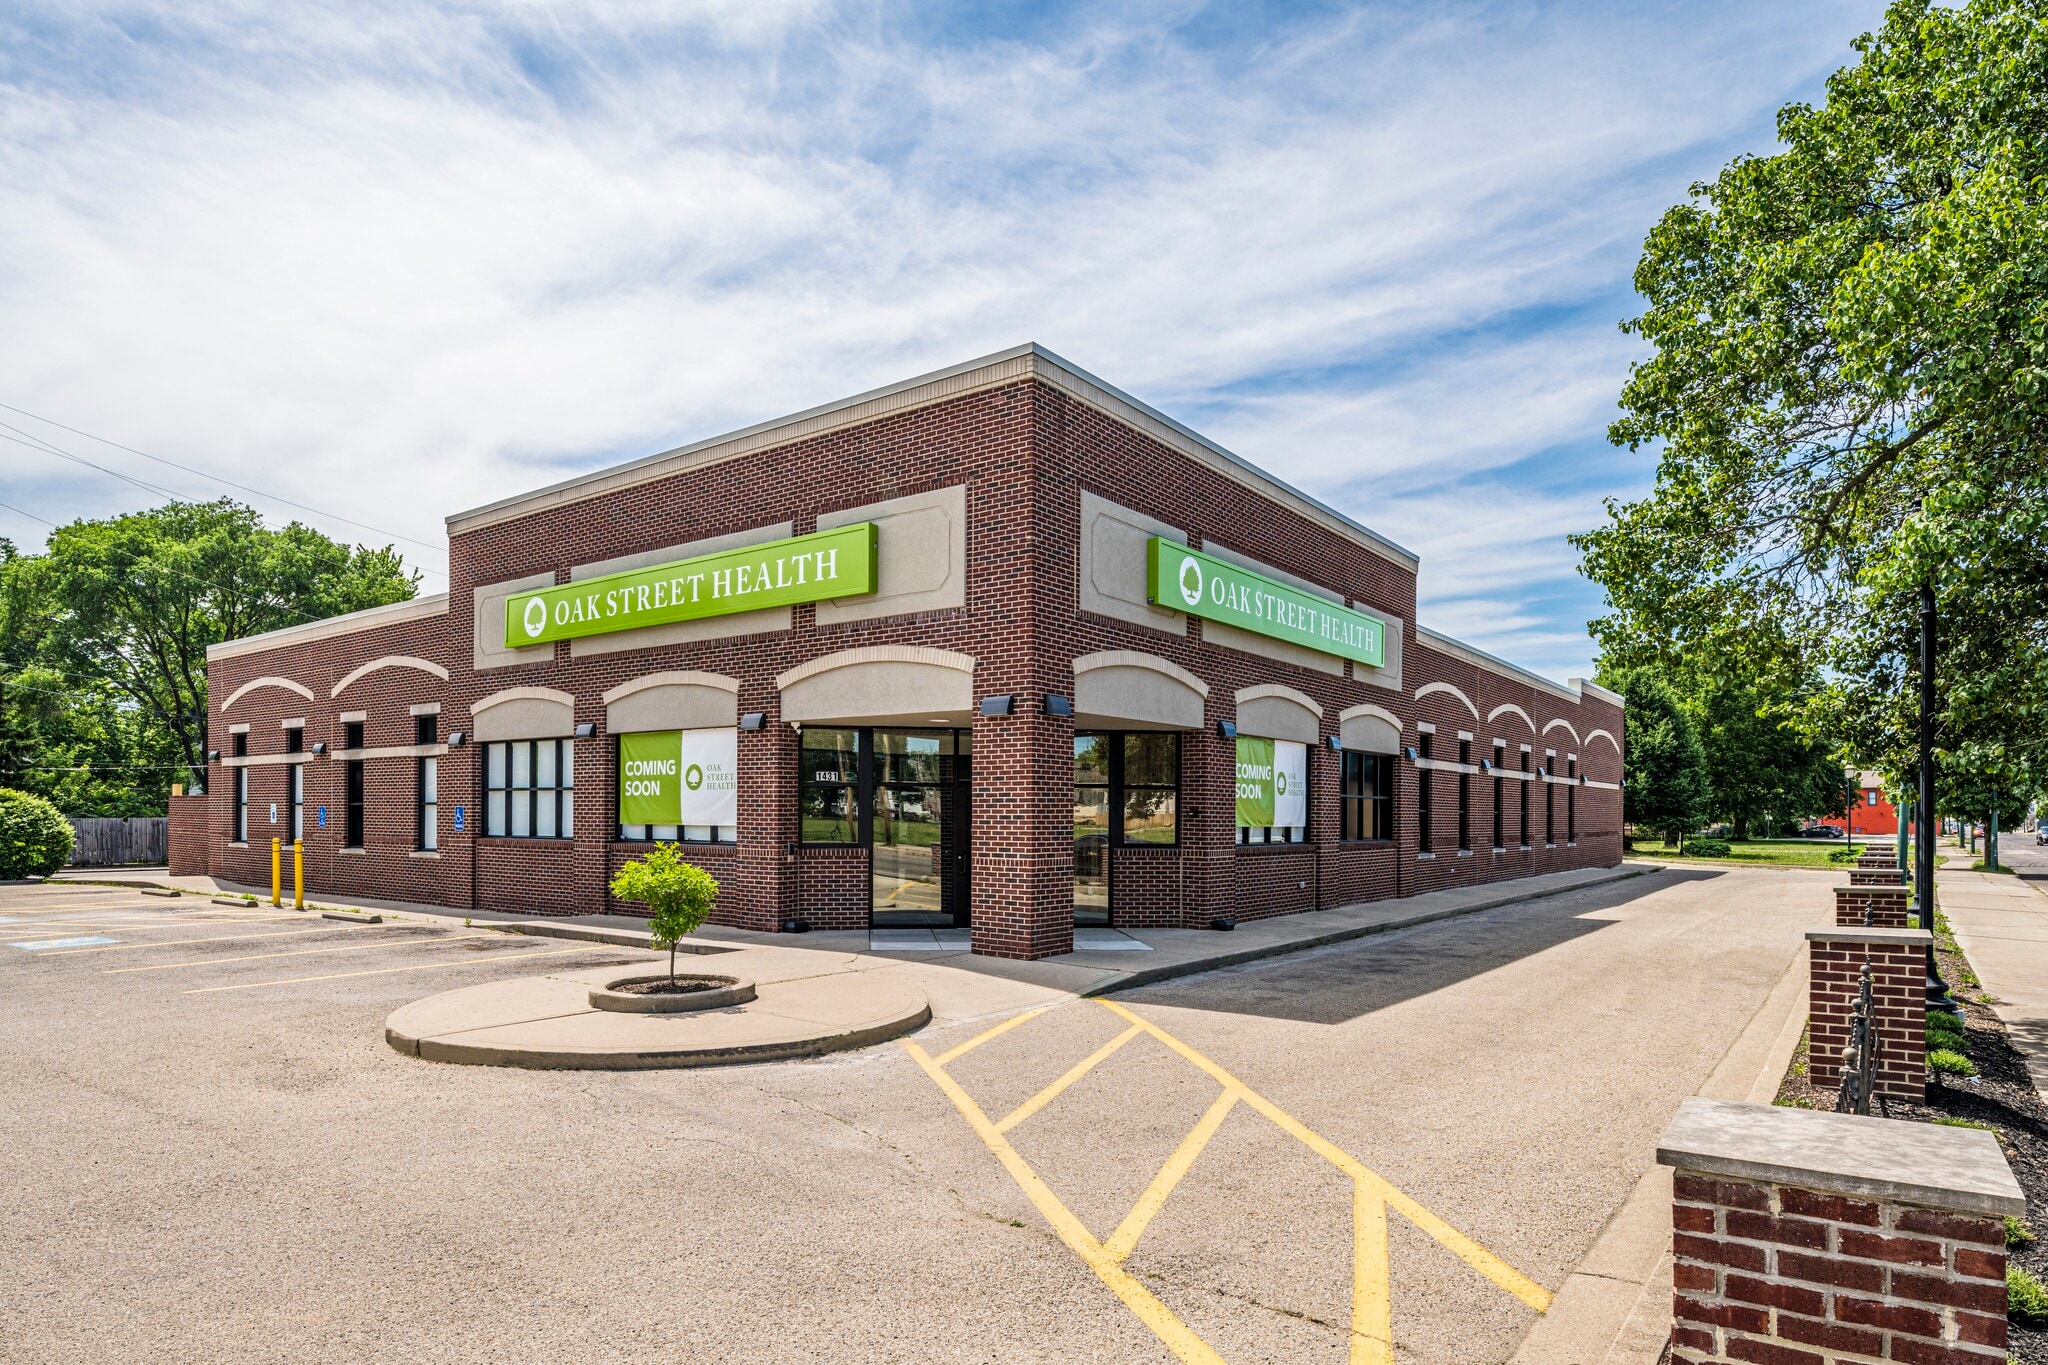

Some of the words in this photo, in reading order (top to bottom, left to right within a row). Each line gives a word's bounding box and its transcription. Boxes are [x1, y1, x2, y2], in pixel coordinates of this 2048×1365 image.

[555, 594, 601, 626] OAK
[606, 573, 705, 617] STREET
[711, 549, 838, 598] HEALTH
[1211, 577, 1251, 614] OAK
[1255, 591, 1317, 634] STREET
[1321, 614, 1374, 652] HEALTH
[625, 760, 676, 777] COMING
[817, 772, 838, 781] 1431
[1236, 763, 1271, 780] COMING
[707, 773, 735, 781] STREET
[625, 781, 660, 797] SOON
[707, 782, 736, 790] HEALTH
[1236, 784, 1261, 799] SOON
